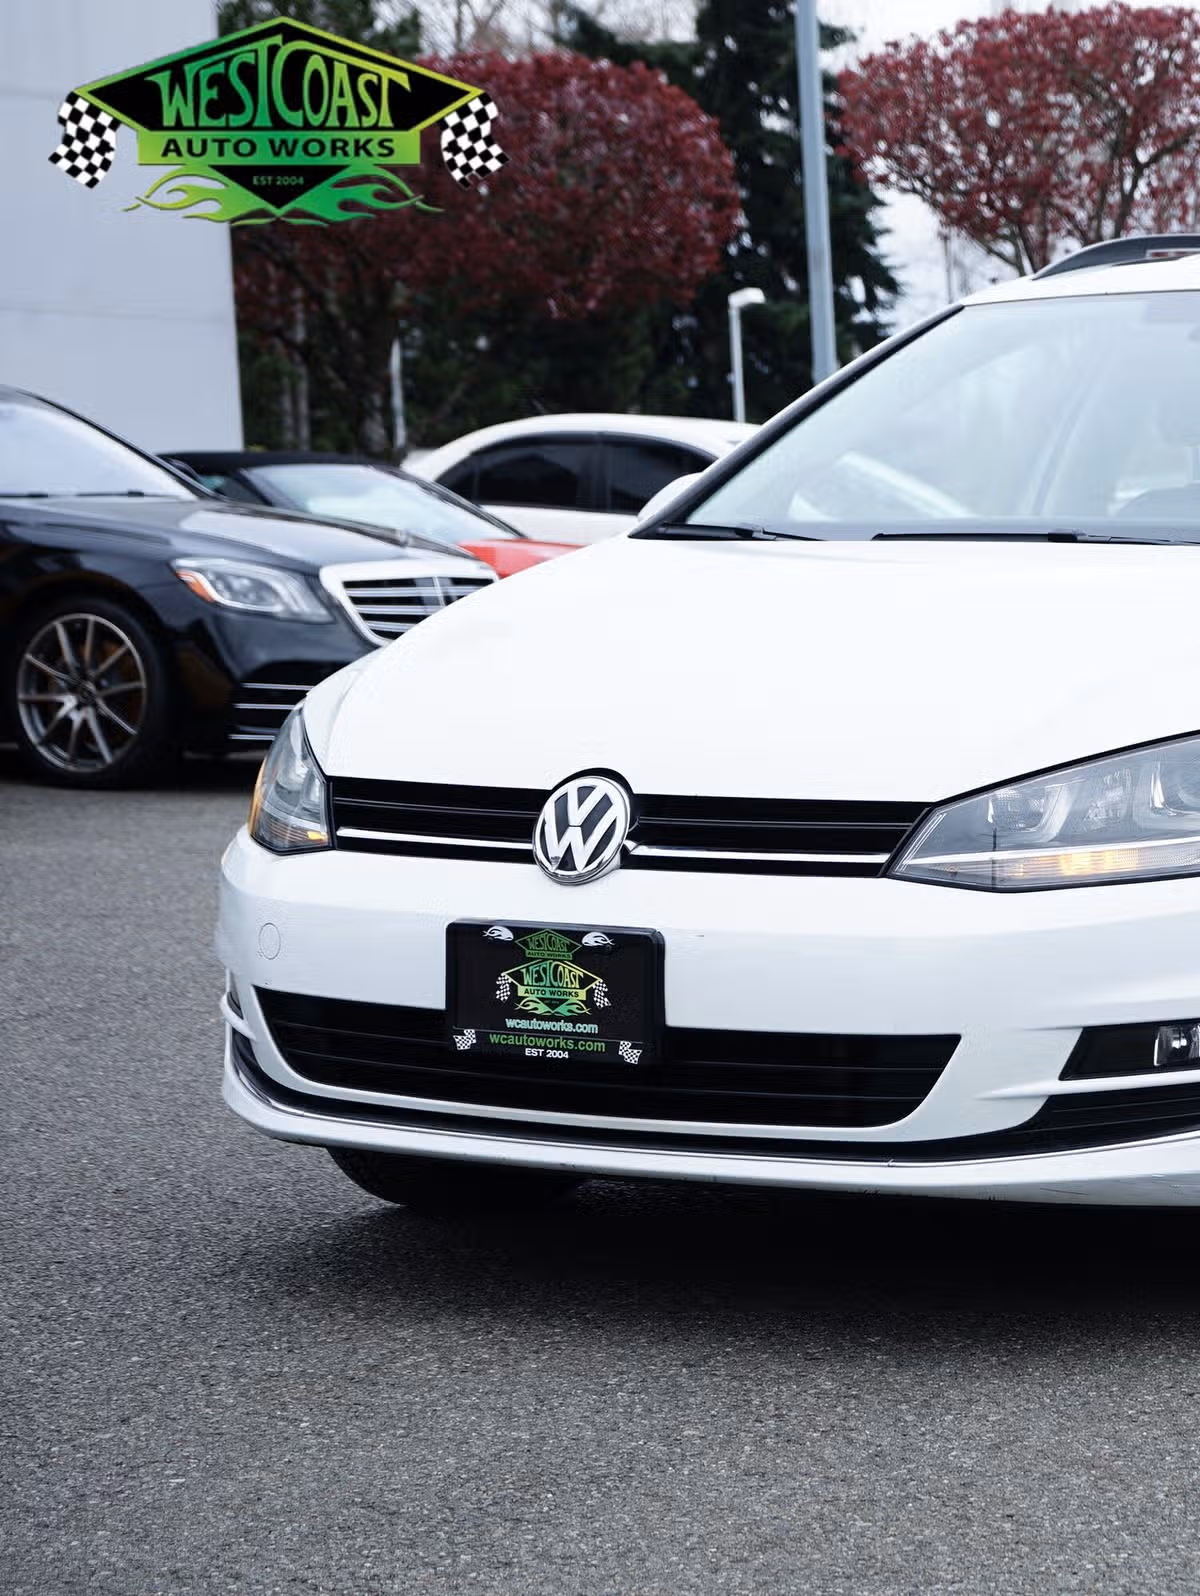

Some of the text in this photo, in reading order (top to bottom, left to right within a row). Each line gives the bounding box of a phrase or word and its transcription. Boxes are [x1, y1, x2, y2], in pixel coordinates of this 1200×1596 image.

[524, 988, 579, 998] AUTO WORKS
[505, 1018, 598, 1033] wcautoworks.com
[489, 1034, 606, 1052] wcautoworks.com
[525, 1048, 569, 1059] EST 2004
